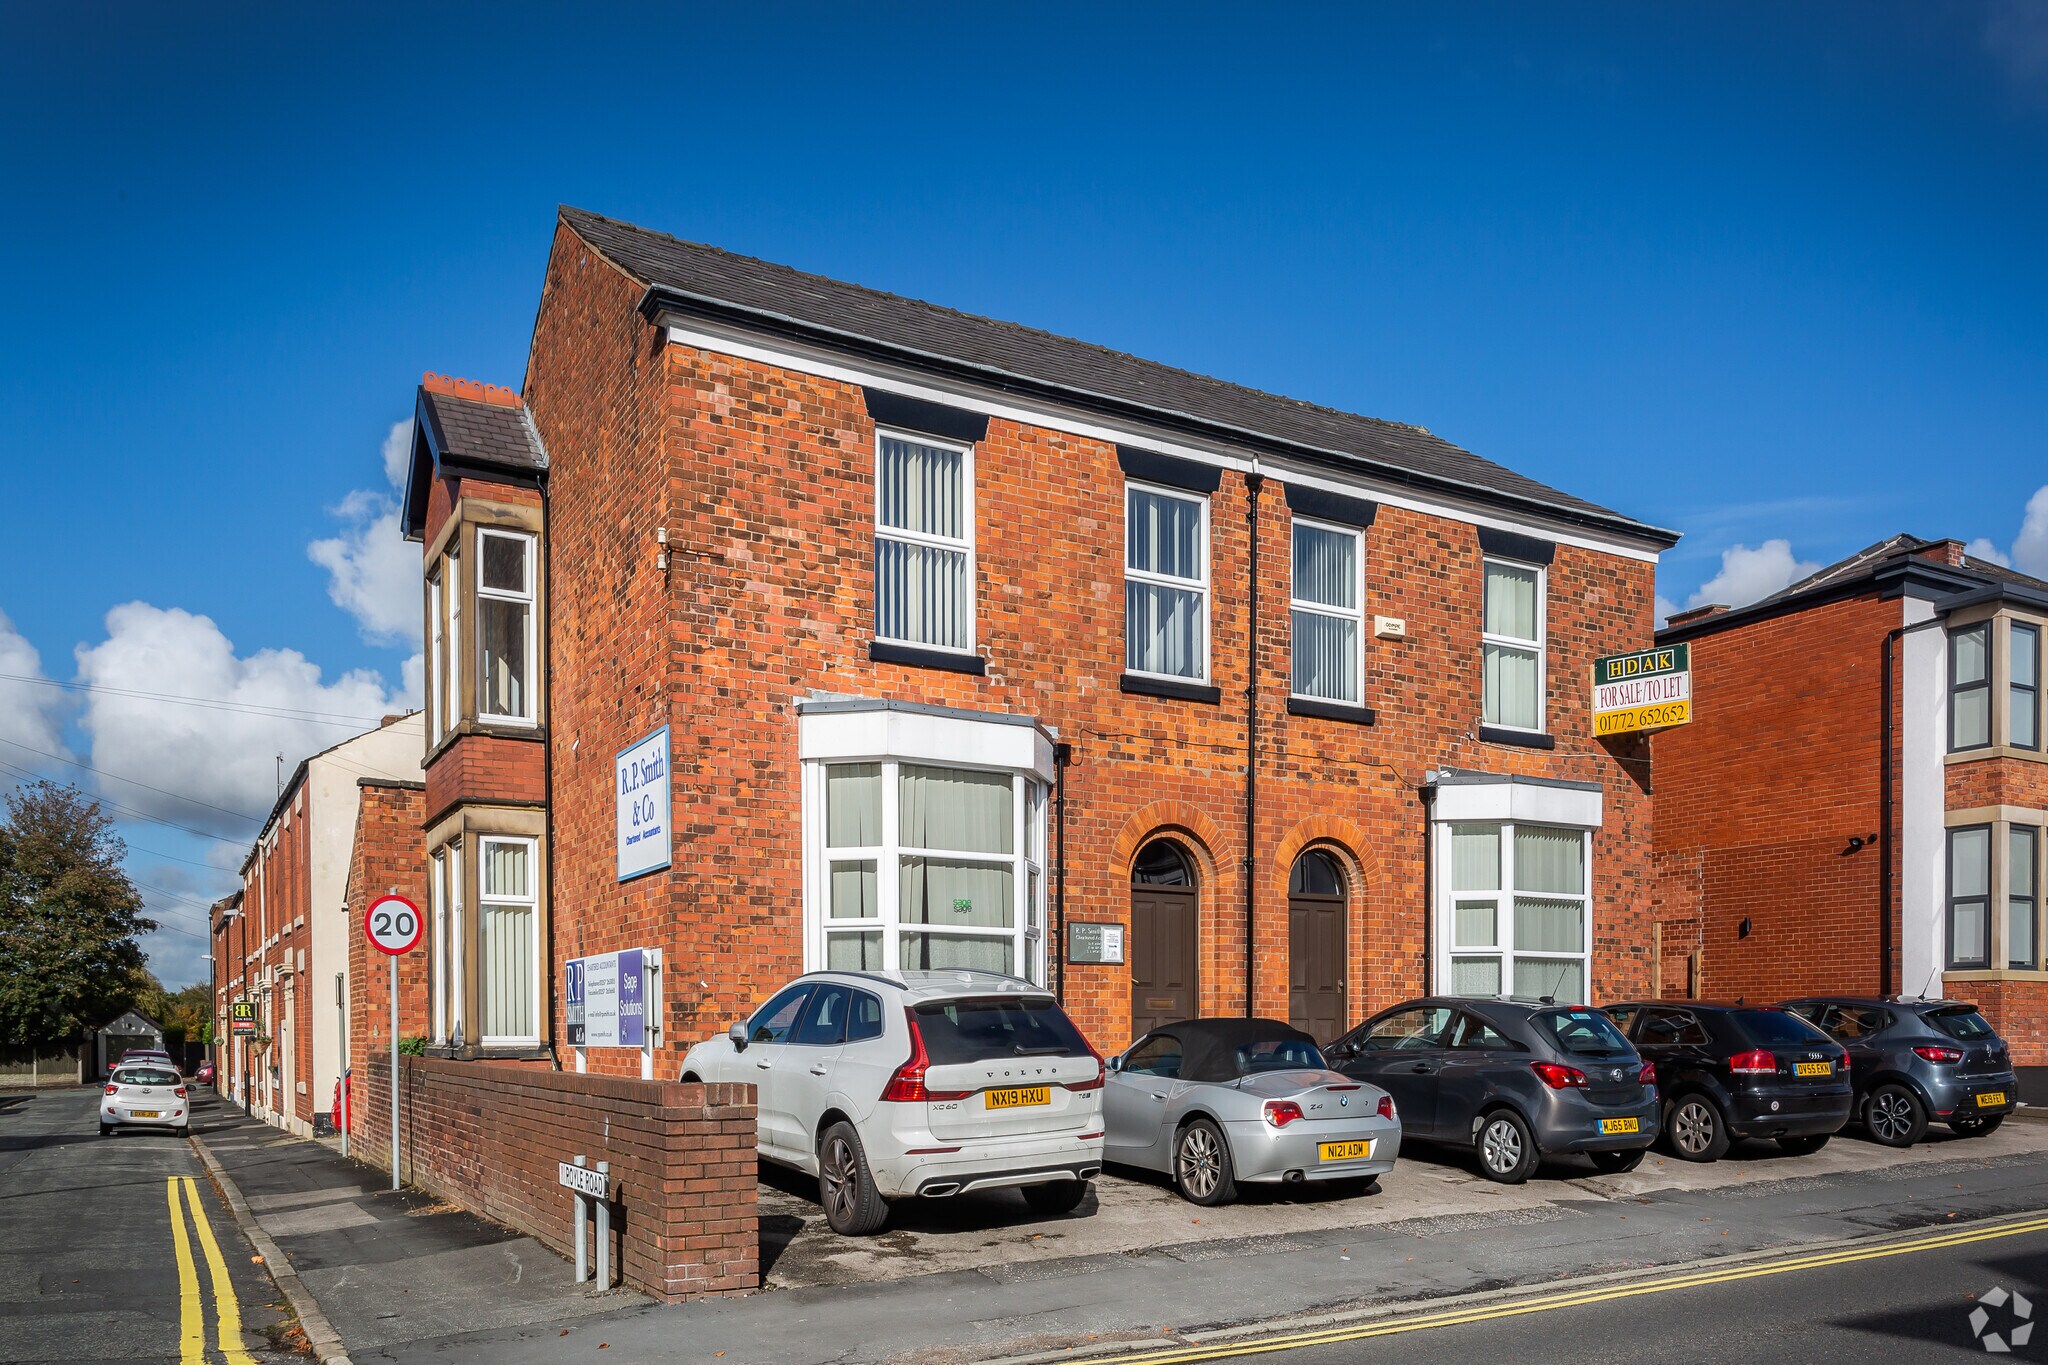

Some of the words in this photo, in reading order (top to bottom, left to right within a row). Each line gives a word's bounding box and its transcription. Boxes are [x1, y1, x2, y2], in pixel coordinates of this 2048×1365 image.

[1610, 653, 1671, 677] HDAK
[1600, 687, 1618, 708] FOR
[1663, 676, 1682, 698] LET
[1600, 713, 1634, 731] 01772
[1640, 705, 1685, 726] 652652
[640, 747, 665, 787] Smith
[633, 801, 641, 826] &
[643, 794, 654, 823] Co
[375, 912, 415, 936] 20
[567, 965, 575, 1002] R
[576, 963, 584, 1001] P
[624, 973, 637, 992] Sage
[567, 1004, 585, 1023] SMITH
[620, 999, 643, 1017] Solutions
[987, 1068, 1057, 1078] VOLVO
[1797, 1064, 1816, 1075] DV55
[1817, 1063, 1830, 1073] EKN
[992, 1091, 1018, 1106] NX19
[1021, 1088, 1044, 1103] HXU
[1603, 1120, 1623, 1132] MJ65
[1623, 1119, 1637, 1130] BNU
[1348, 1143, 1364, 1156] ADM
[566, 1166, 584, 1189] ROYLE
[586, 1172, 604, 1195] ROAD
